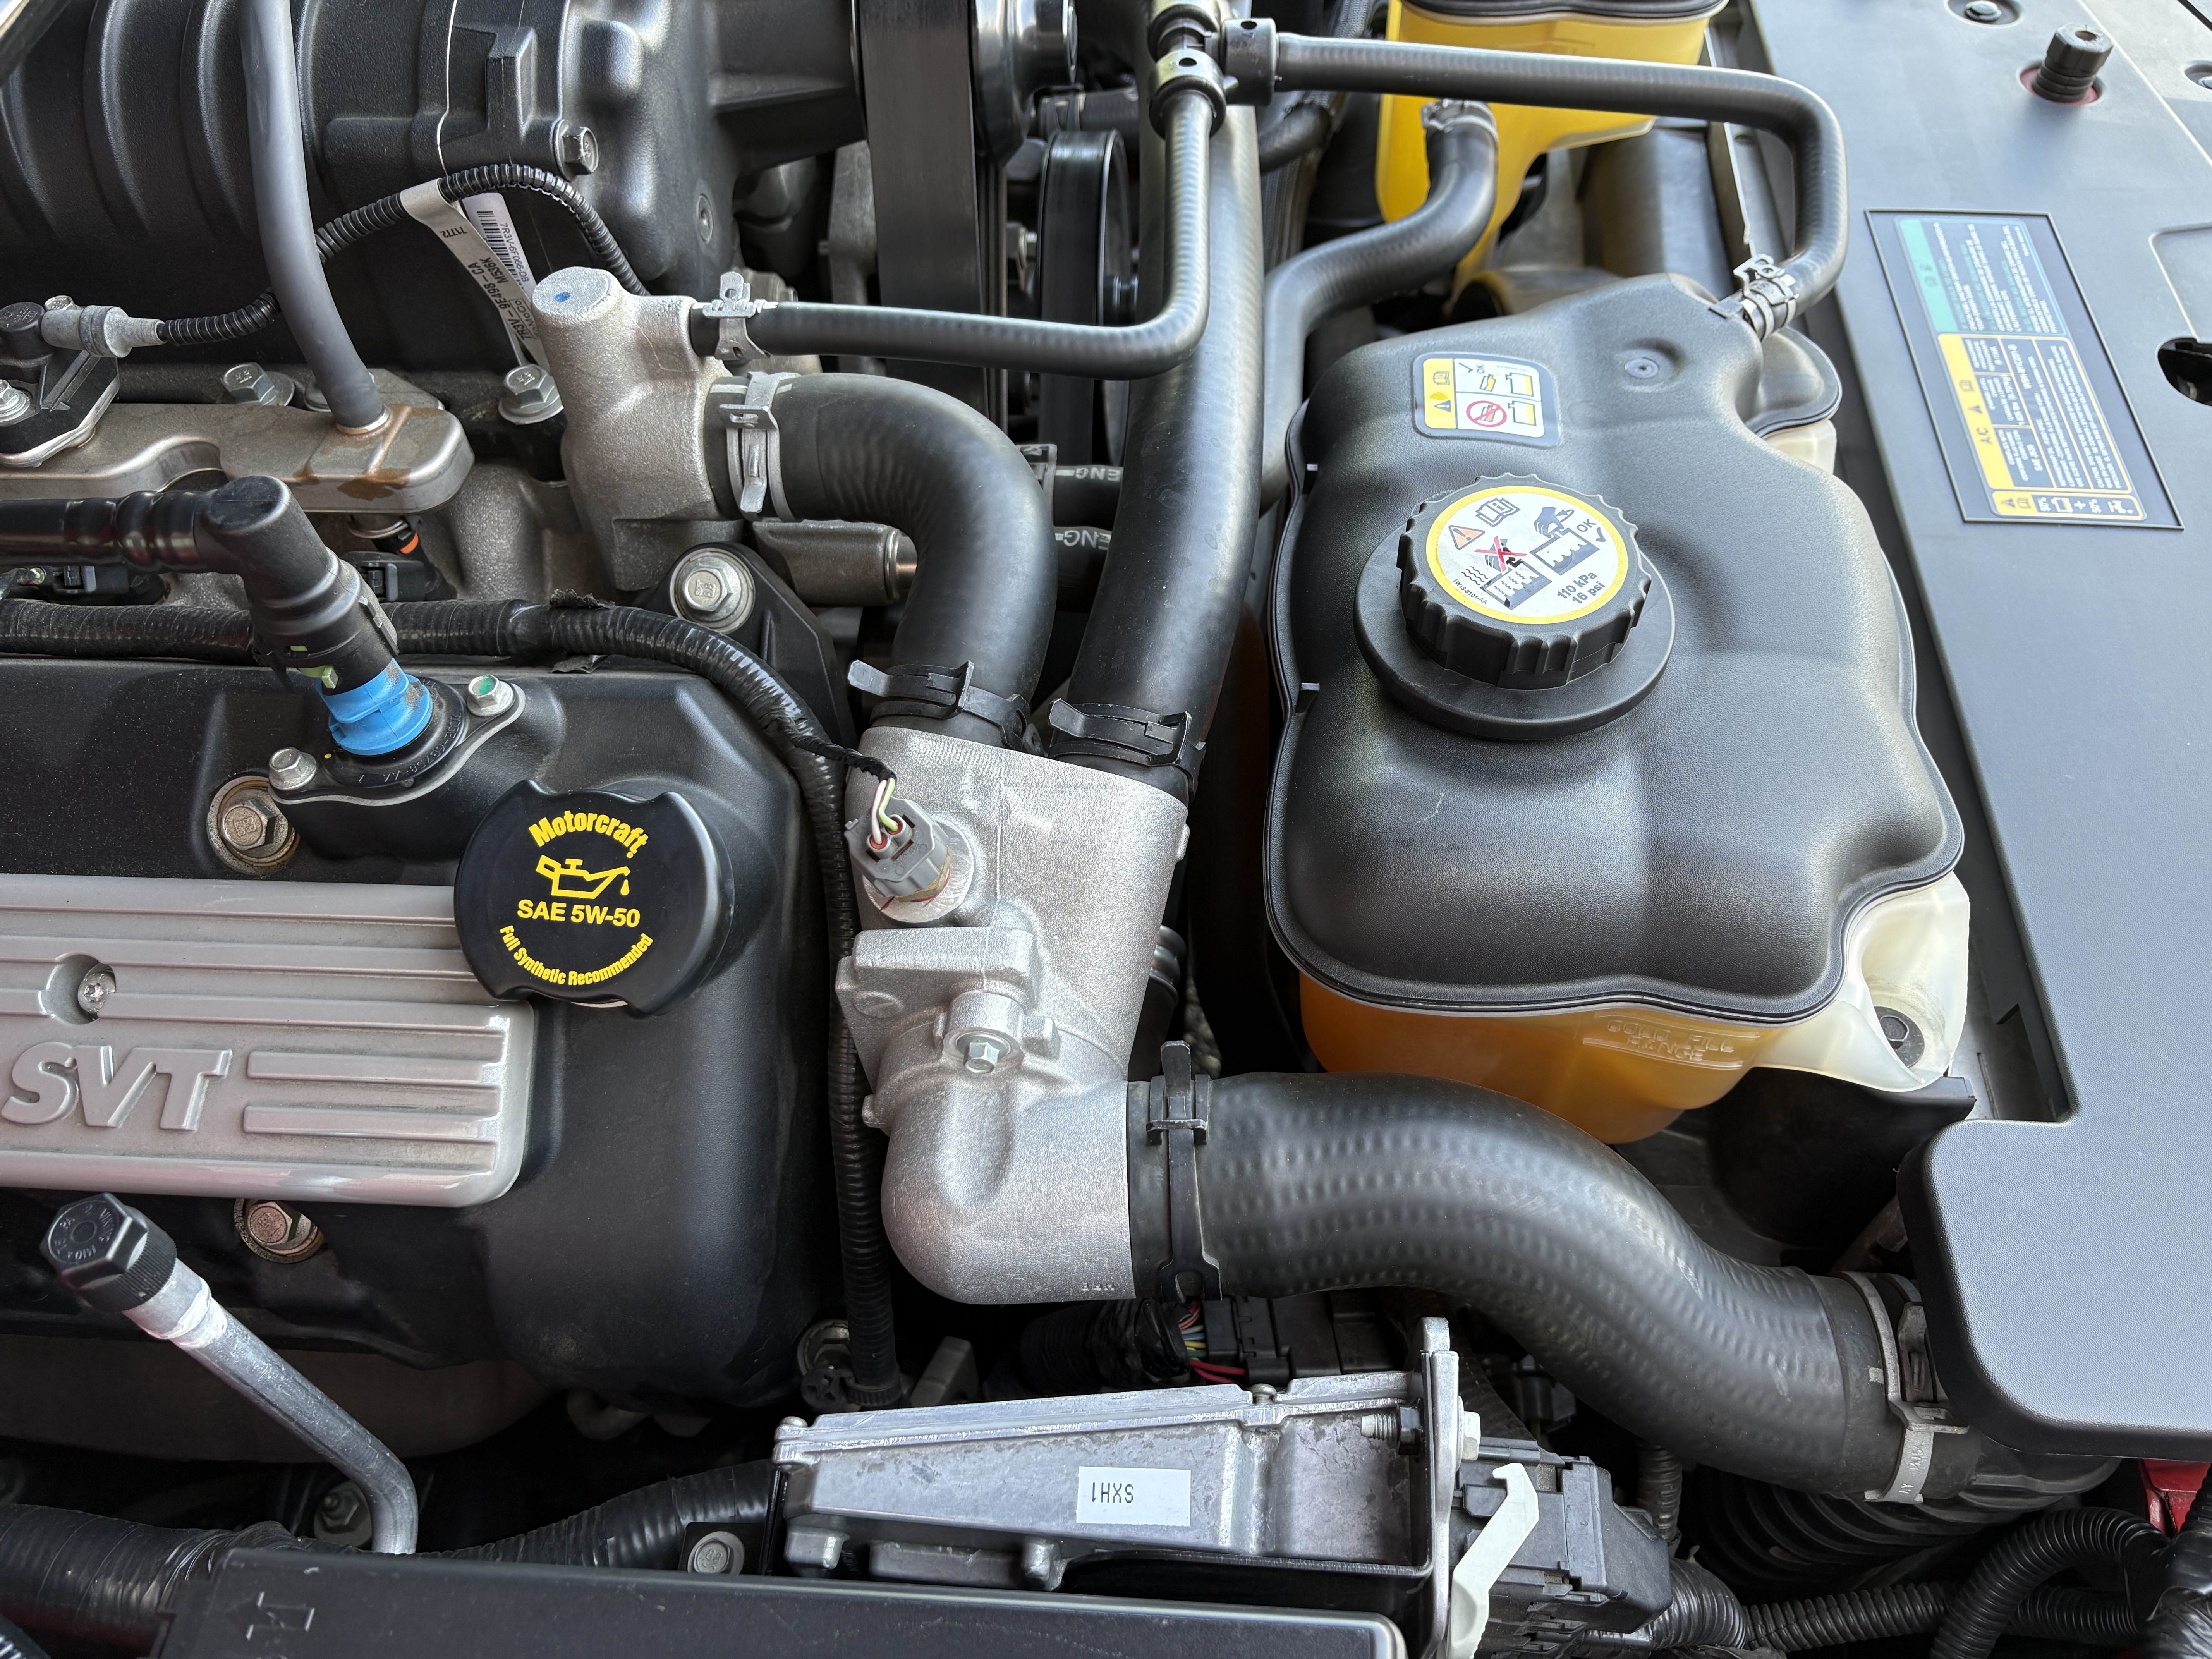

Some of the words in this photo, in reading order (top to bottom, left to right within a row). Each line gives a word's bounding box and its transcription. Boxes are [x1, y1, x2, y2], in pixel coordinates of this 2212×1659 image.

[1476, 364, 1485, 374] OK
[1973, 427, 1994, 445] A/C
[1075, 467, 1121, 482] ENG
[1576, 518, 1597, 533] OK
[1063, 529, 1112, 550] ENG
[1557, 584, 1577, 600] 110
[1575, 572, 1598, 591] kPa
[1572, 591, 1589, 605] 16
[1587, 581, 1606, 598] psi
[529, 810, 649, 854] Motorcraft
[517, 899, 567, 922] SAE
[570, 905, 641, 928] 5W-50
[500, 925, 521, 951] Full
[514, 947, 567, 985] Synthetic
[568, 933, 654, 986] Recommended
[1, 1041, 233, 1132] SVT
[1092, 1482, 1134, 1504] SXH1
